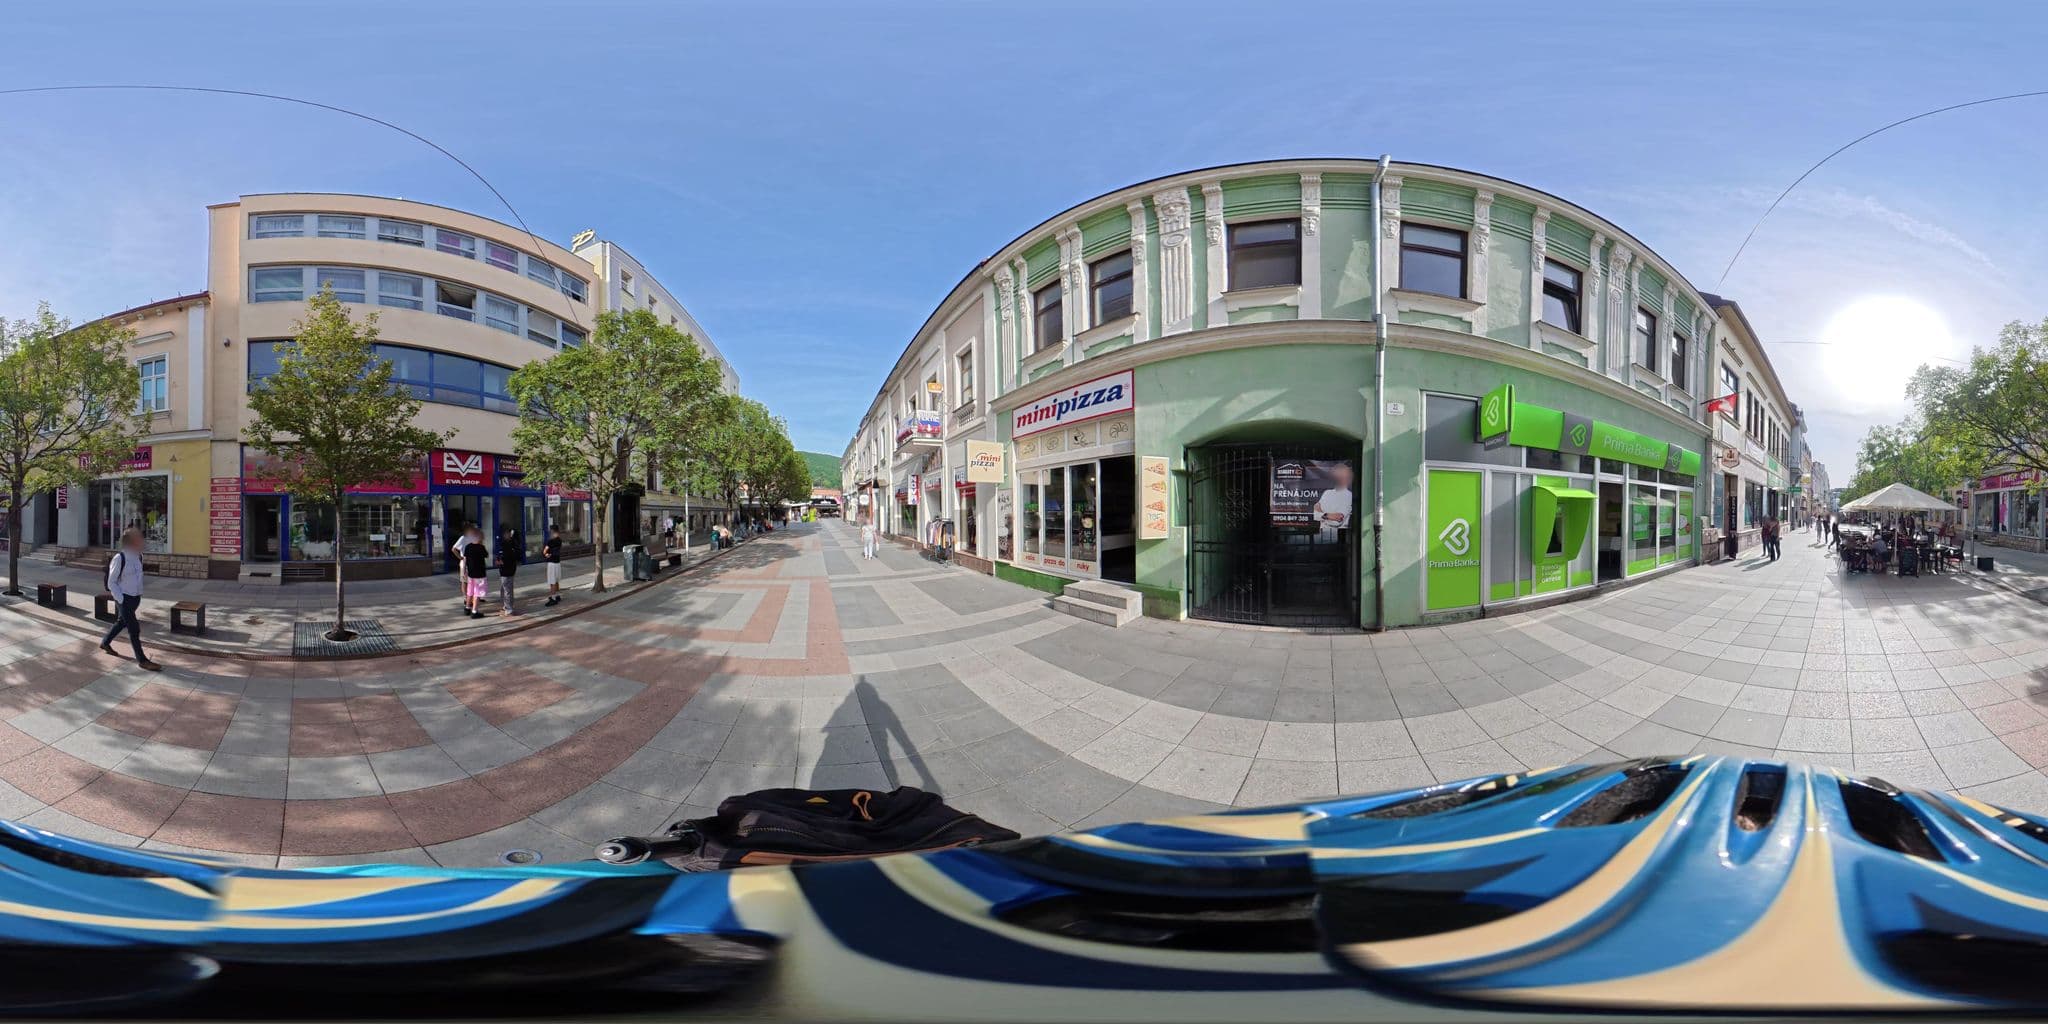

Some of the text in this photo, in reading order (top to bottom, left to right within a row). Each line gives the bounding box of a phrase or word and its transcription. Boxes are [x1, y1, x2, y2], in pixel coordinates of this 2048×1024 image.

[1603, 435, 1661, 461] Prima Banka
[443, 452, 482, 477] EVA
[970, 460, 995, 468] pizza
[1274, 489, 1319, 498] PRENÁJOM
[1429, 558, 1481, 568] Prima Banka
